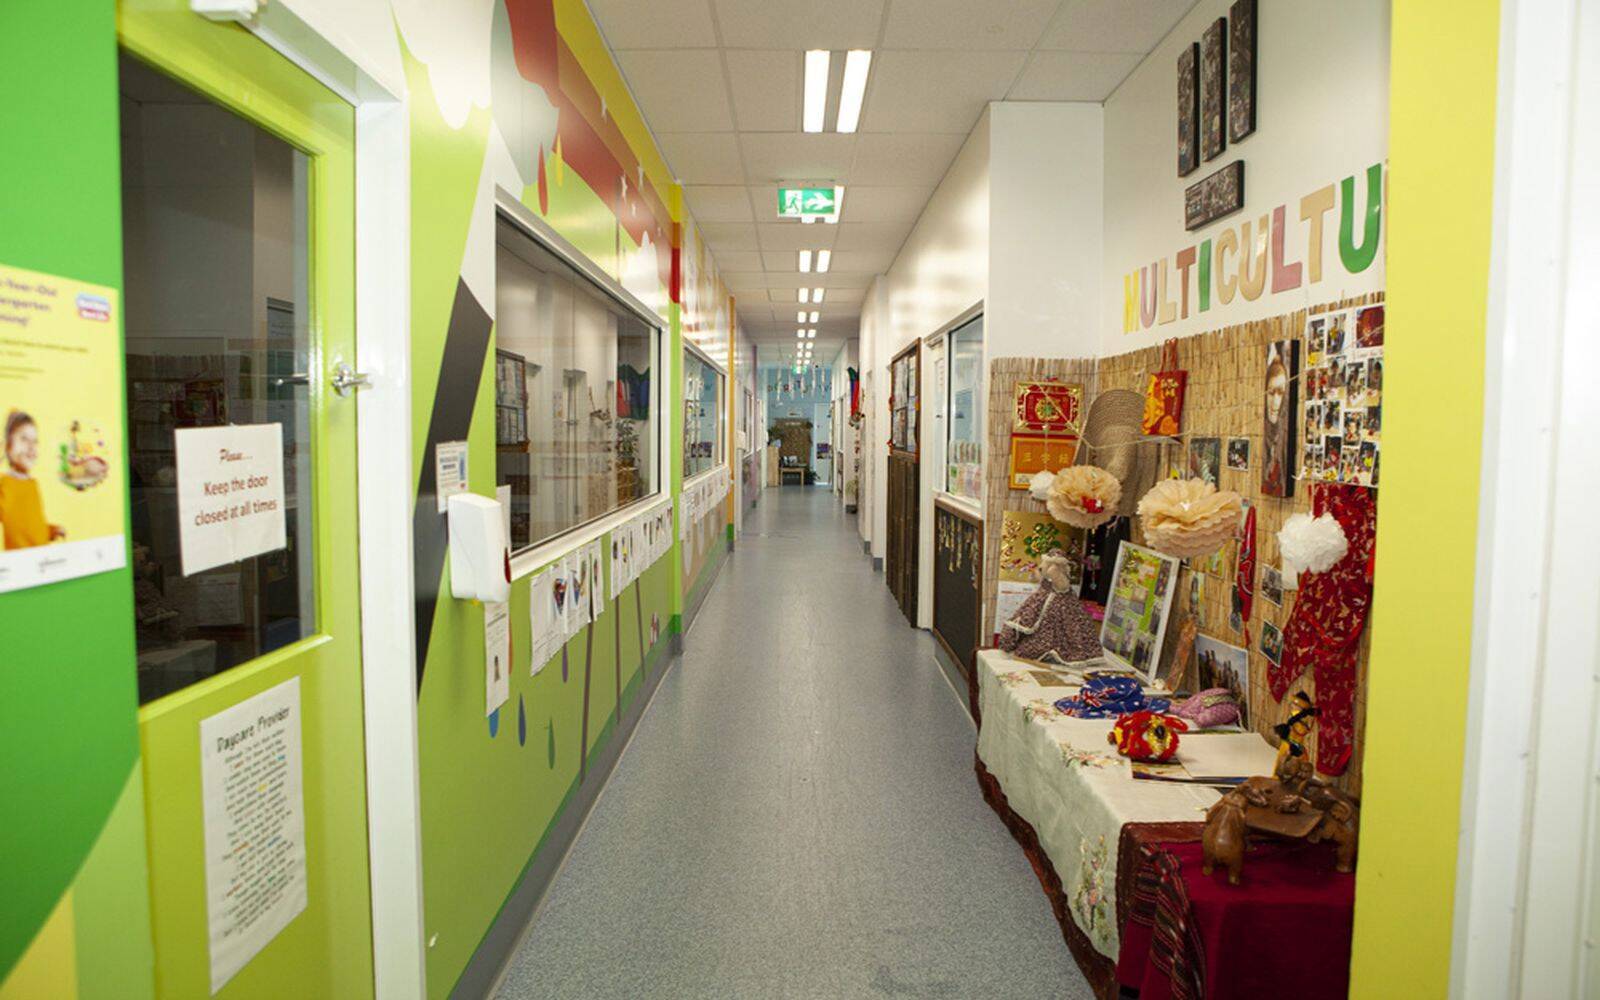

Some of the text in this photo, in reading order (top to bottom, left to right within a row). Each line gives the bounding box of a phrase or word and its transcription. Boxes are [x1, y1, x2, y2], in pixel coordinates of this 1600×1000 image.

[1123, 159, 1388, 334] MULTICULTU
[204, 474, 268, 496] Keep the door
[196, 499, 278, 526] closed at all times
[217, 707, 289, 752] Daycare Provider
